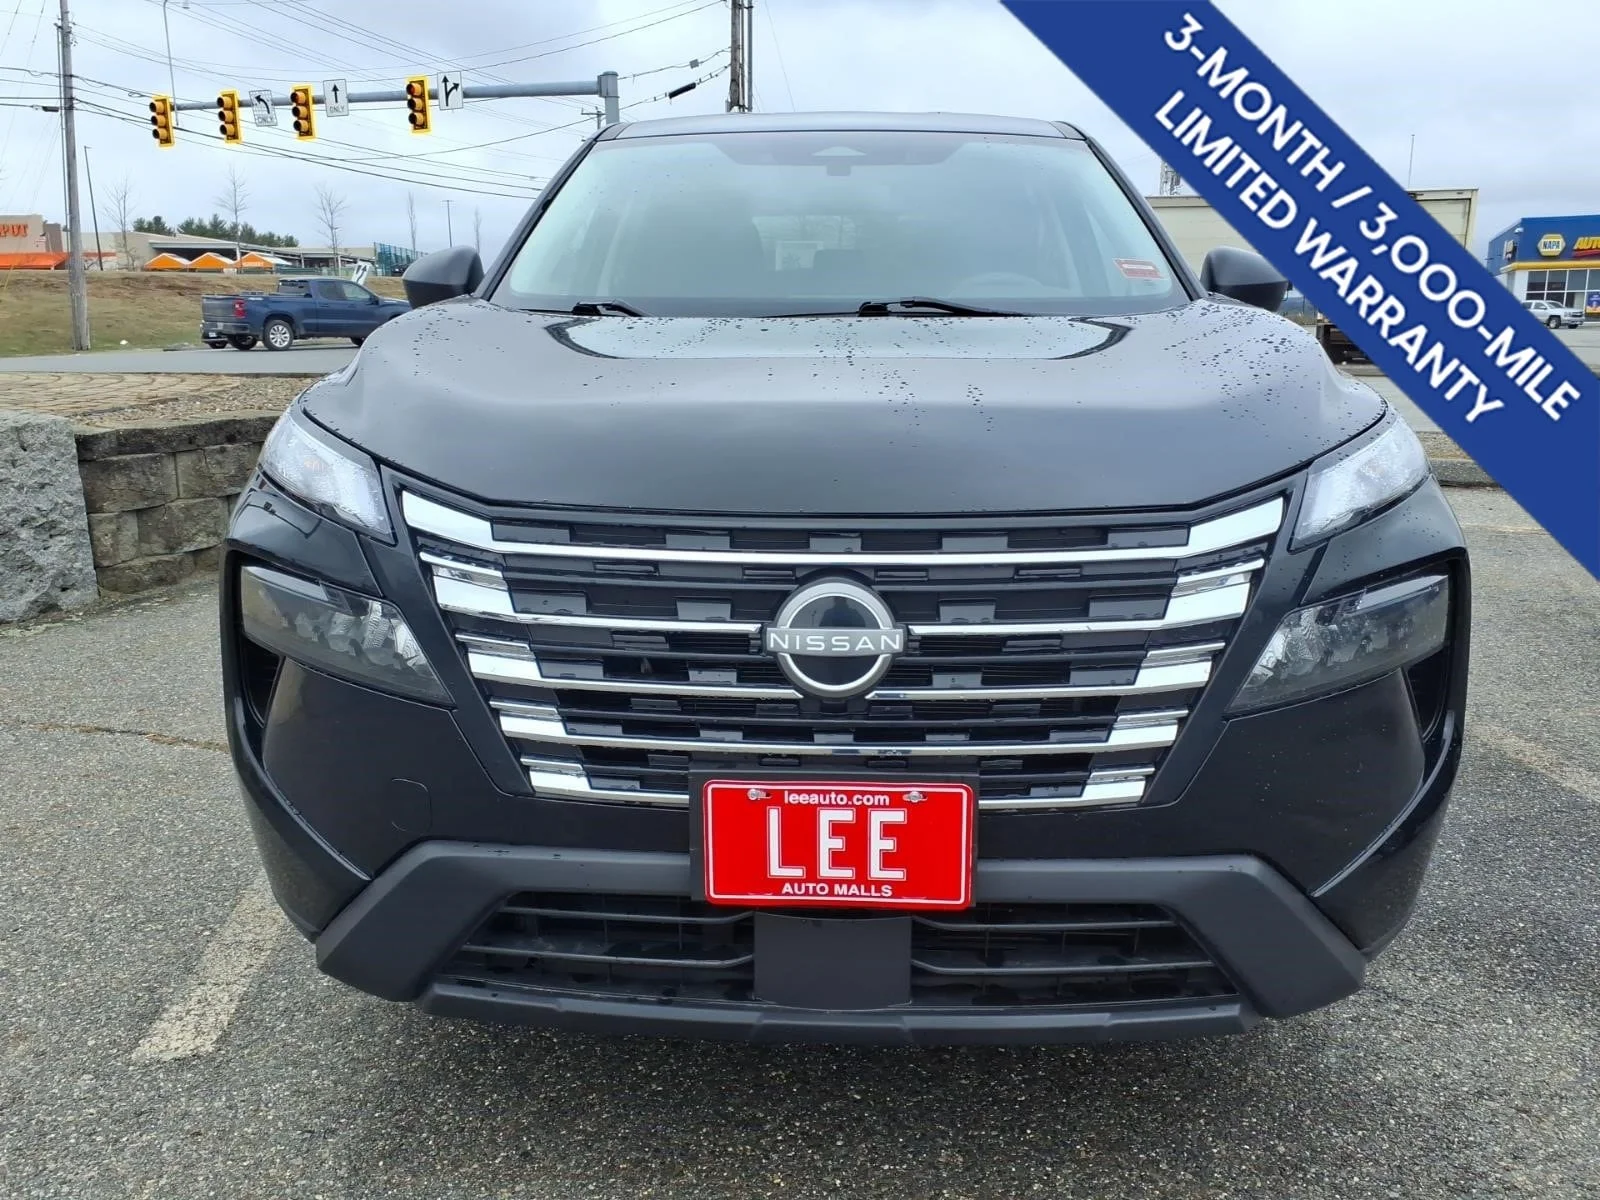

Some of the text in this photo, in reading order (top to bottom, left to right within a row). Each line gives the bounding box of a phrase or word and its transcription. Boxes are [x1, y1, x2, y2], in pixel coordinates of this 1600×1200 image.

[1542, 240, 1561, 250] NAPA
[769, 631, 901, 652] NISSAN
[784, 790, 890, 806] leeauto.com
[767, 806, 907, 881] LEE
[782, 882, 893, 897] AUTO MALLS
